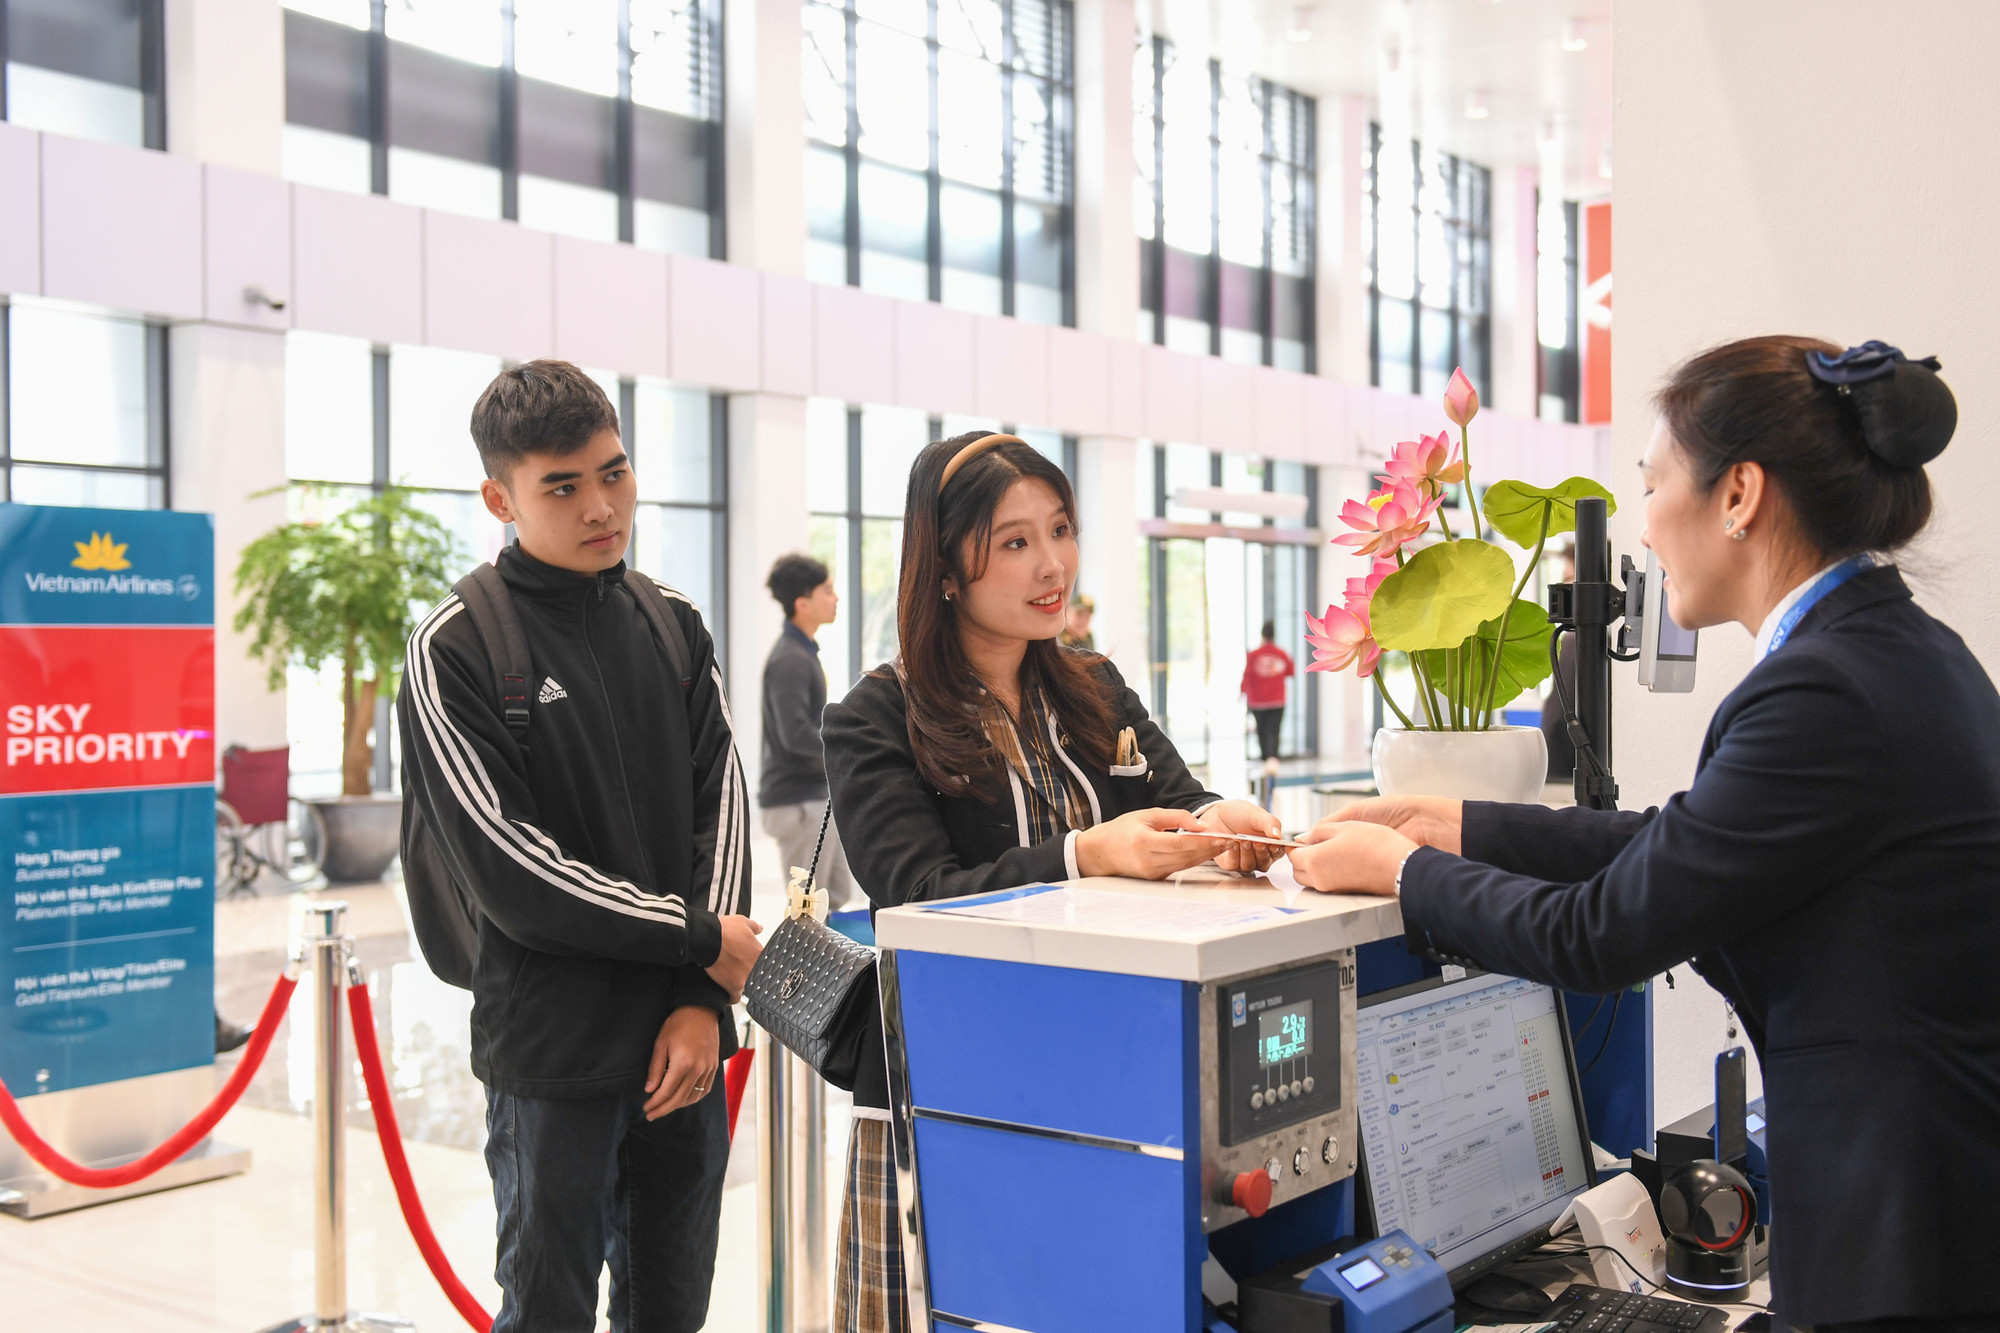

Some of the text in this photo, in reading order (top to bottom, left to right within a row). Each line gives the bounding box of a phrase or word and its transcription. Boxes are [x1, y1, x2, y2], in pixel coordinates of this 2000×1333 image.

[538, 689, 568, 704] adidas
[7, 703, 92, 735] SKY
[7, 731, 194, 766] PRIORITY
[15, 863, 106, 882] Business Class
[177, 875, 203, 890] Plus
[98, 899, 124, 914] Plus
[125, 895, 172, 911] Member
[126, 975, 173, 992] Member
[1720, 1266, 1742, 1275] Honeywell
